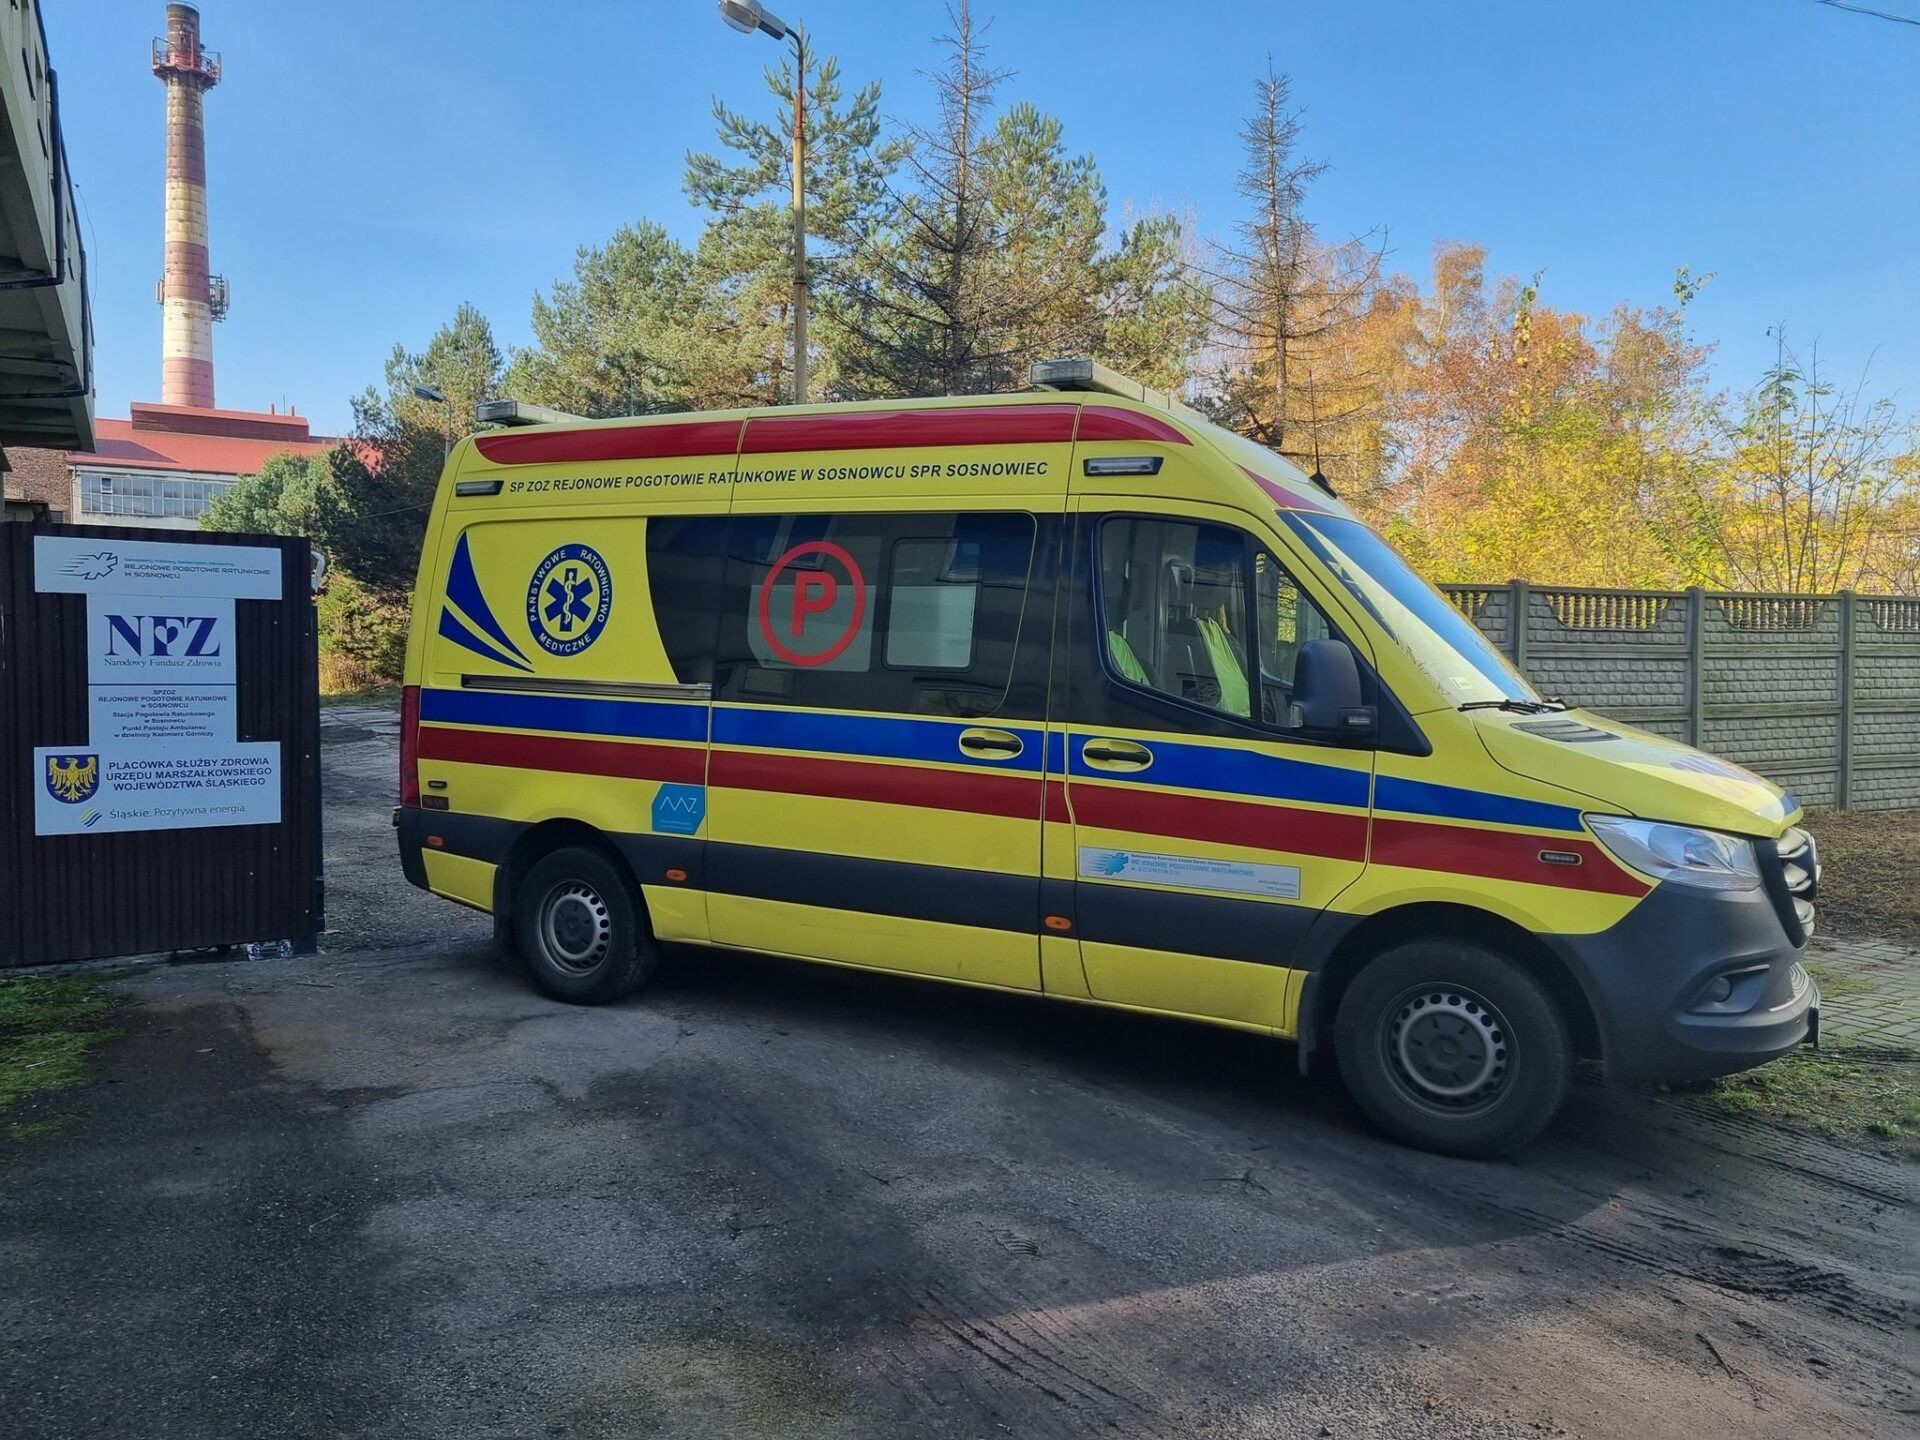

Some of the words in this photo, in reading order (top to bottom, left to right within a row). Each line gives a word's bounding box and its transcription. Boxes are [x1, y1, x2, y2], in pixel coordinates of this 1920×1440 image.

[509, 481, 525, 493] SP
[527, 480, 551, 492] ZOZ
[553, 476, 622, 491] REJONOWE
[625, 472, 705, 488] POGOTOWIE
[708, 469, 796, 484] RATUNKOWE
[801, 467, 815, 481] W
[817, 465, 906, 480] SOSNOWCU
[910, 463, 941, 478] SPR
[946, 461, 1049, 477] SOSNOWIEC
[124, 563, 171, 571] REJONOWE
[172, 565, 220, 574] POGOTOWIE
[221, 567, 271, 576] RATUNKOWE
[579, 549, 610, 623] RATOWNICTWO
[791, 571, 837, 637] P
[103, 614, 221, 657] NFZ
[539, 633, 592, 653] MEDYCZNE
[104, 658, 146, 668] Narodowy
[149, 658, 185, 667] Fundusz
[187, 659, 222, 667] Zdrowia
[121, 731, 151, 739] dzielnicy
[185, 729, 215, 738] Górniczy
[108, 758, 174, 771] PLACÓWKA
[175, 757, 218, 769] SŁUŻBY
[220, 757, 270, 767] ZDROWIA
[105, 771, 152, 782] URZĘDU
[155, 767, 272, 779] MARSZAŁKOWSKIEGO
[113, 779, 203, 792] WOJEWÓDZTWA
[205, 777, 266, 789] ŚLĄSKIEGO
[154, 807, 207, 817] Pozytywna
[209, 804, 246, 815] energia
